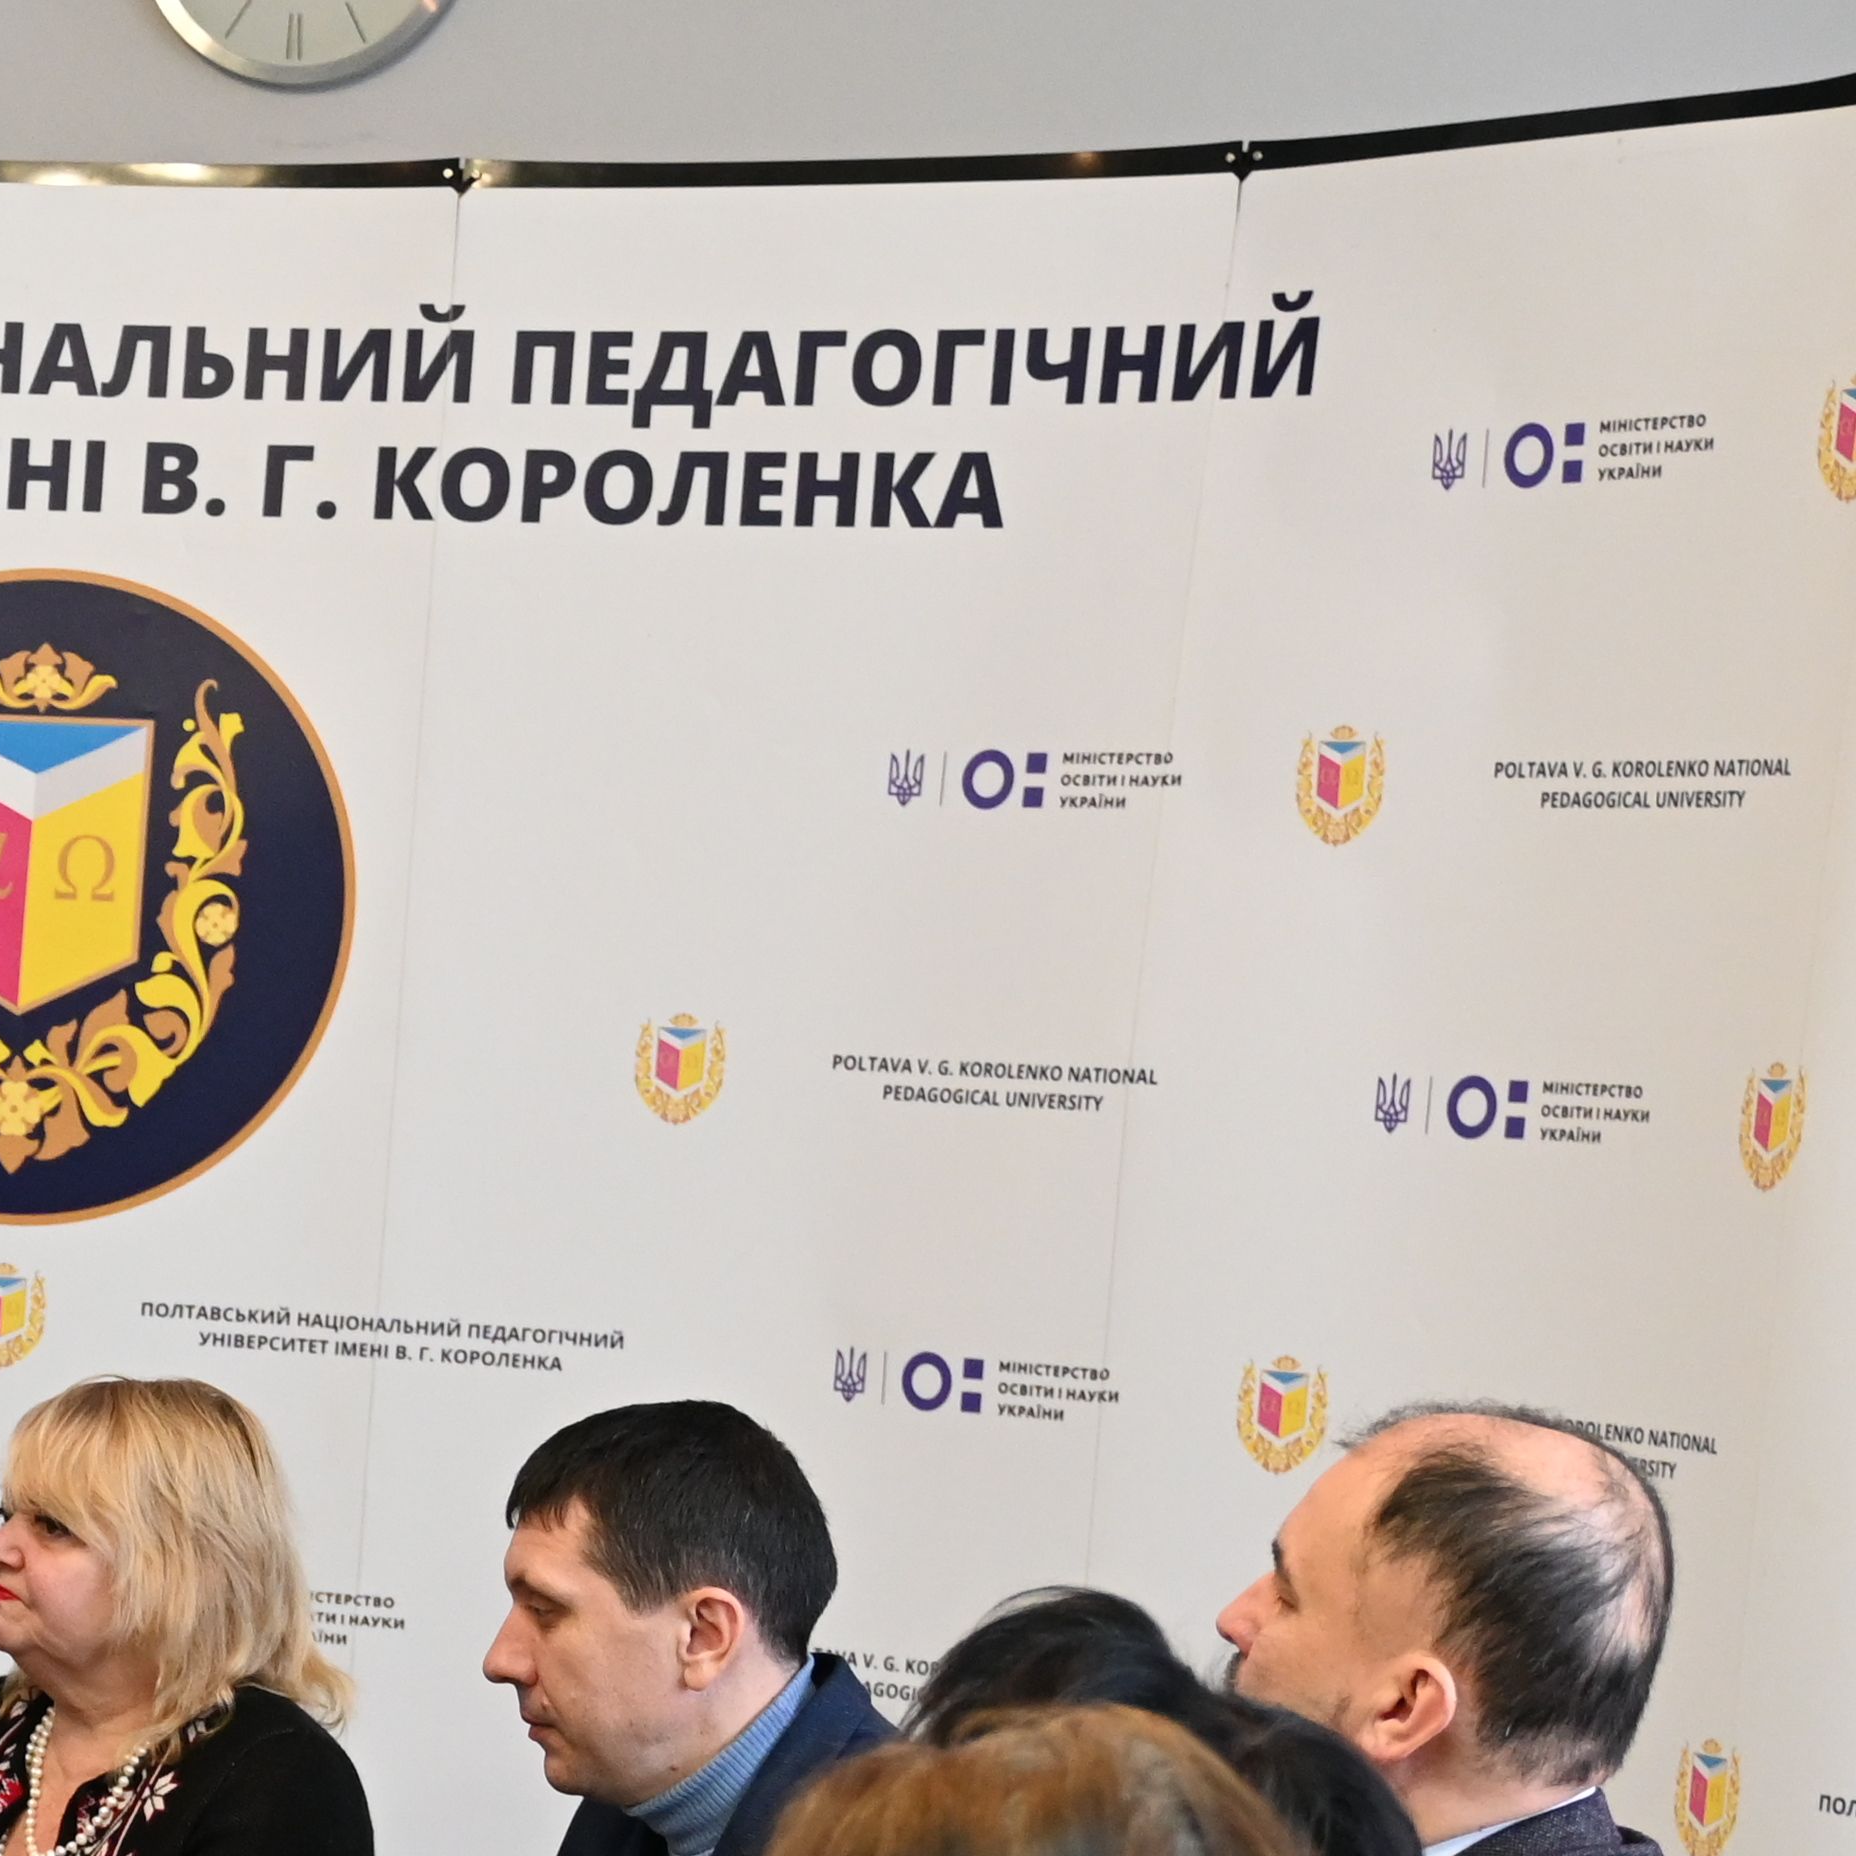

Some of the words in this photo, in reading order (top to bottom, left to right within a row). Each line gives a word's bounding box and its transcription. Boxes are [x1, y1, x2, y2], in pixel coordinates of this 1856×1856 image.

[510, 292, 1321, 430] ПЕДАГОГІЧНИЙ
[1599, 413, 1707, 434] МІНІСТЕРСТВО
[1598, 441, 1654, 458] ОСВІТИ
[1663, 437, 1715, 454] НАУКИ
[1597, 462, 1663, 482] УКРАЇНИ
[141, 441, 226, 517] В.
[261, 444, 338, 520] Г.
[372, 446, 1005, 529] КОРОЛЕНКА
[1062, 751, 1174, 766] МІНІСТЕРСТВО
[1493, 761, 1569, 780] POLTAVA
[1572, 761, 1587, 779] V.
[1591, 760, 1607, 779] G.
[1611, 759, 1710, 779] KOROLENKO
[1713, 757, 1792, 777] NATIONAL
[1060, 773, 1118, 787] ОСВІТИ
[1128, 774, 1182, 788] НАУКИ
[1059, 792, 1127, 809] УКРАЇНИ
[1540, 790, 1651, 809] PEDAGOGICAL
[1655, 789, 1746, 809] UNIVERSITY
[831, 1053, 913, 1075] POLTAVA
[917, 1058, 933, 1076] V.
[937, 1059, 954, 1077] G.
[958, 1060, 1064, 1082] KOROLENKO
[1067, 1066, 1158, 1086] NATIONAL
[882, 1084, 1000, 1107] PEDAGOGICAL
[1005, 1091, 1104, 1112] UNIVERSITY
[1542, 1080, 1644, 1099] МІНІСТЕРСТВО
[1540, 1104, 1594, 1120] ОСВІТИ
[1602, 1107, 1651, 1123] НАУКИ
[1540, 1126, 1602, 1144] УКРАЇНИ
[140, 1301, 291, 1326] ПОЛТАВСЬКИЙ
[296, 1311, 462, 1338] НАЦІОНАЛЬНИЙ
[467, 1323, 625, 1350] ПЕДАГОГІЧНИЙ
[199, 1331, 329, 1355] УНІВЕРСИТЕТ
[334, 1340, 389, 1359] ІМЕНІ
[395, 1344, 412, 1361] В.
[418, 1346, 434, 1363] Г.
[440, 1348, 563, 1372] КОРОЛЕНКА
[998, 1360, 1111, 1382] МІНІСТЕРСТВО
[997, 1381, 1055, 1399] ОСВІТИ
[1065, 1388, 1120, 1404] НАУКИ
[997, 1403, 1065, 1422] УКРАЇНИ
[1647, 1429, 1719, 1456] NATIONAL
[349, 1615, 406, 1630] НАУКИ
[862, 1652, 878, 1670] V.
[883, 1655, 900, 1673] G.
